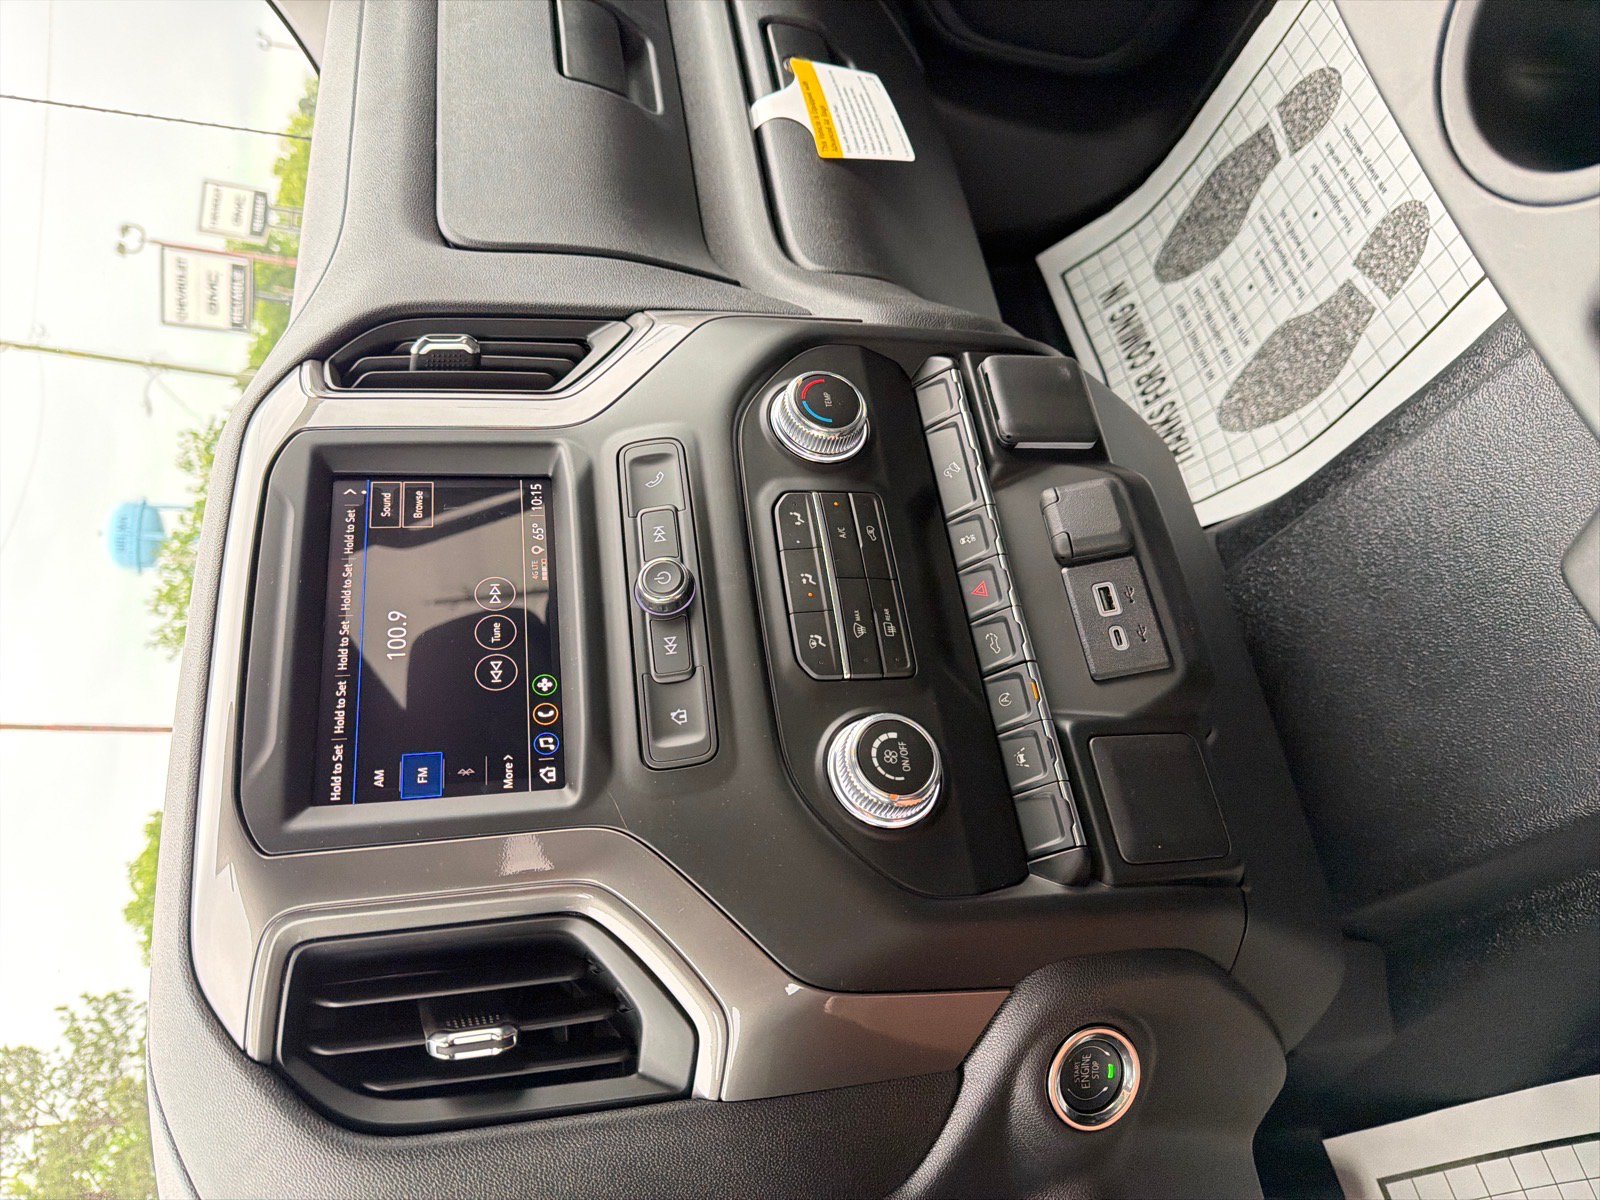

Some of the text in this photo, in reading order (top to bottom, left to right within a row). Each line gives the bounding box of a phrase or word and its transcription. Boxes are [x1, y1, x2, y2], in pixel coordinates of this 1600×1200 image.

[1097, 281, 1129, 308] IN
[1108, 303, 1154, 370] COMING
[1135, 362, 1170, 406] FOR
[823, 391, 832, 406] TEMP
[381, 492, 391, 517] Sound
[413, 490, 423, 518] Browse
[530, 483, 542, 511] 10:15
[344, 509, 355, 554] Hold to Set
[837, 527, 846, 538] A/C
[340, 563, 352, 610] Hold to Set
[338, 621, 350, 670] Hold to Set
[387, 610, 407, 661] 100.9
[491, 623, 501, 643] Tune
[334, 680, 346, 733] Hold to Set
[898, 741, 910, 771] ON/OFF
[330, 744, 343, 800] Hold to Set
[374, 769, 384, 787] AM
[417, 767, 428, 783] FM
[503, 762, 513, 788] More
[1080, 1053, 1091, 1088] ENGINE
[1091, 1061, 1099, 1079] STOP
